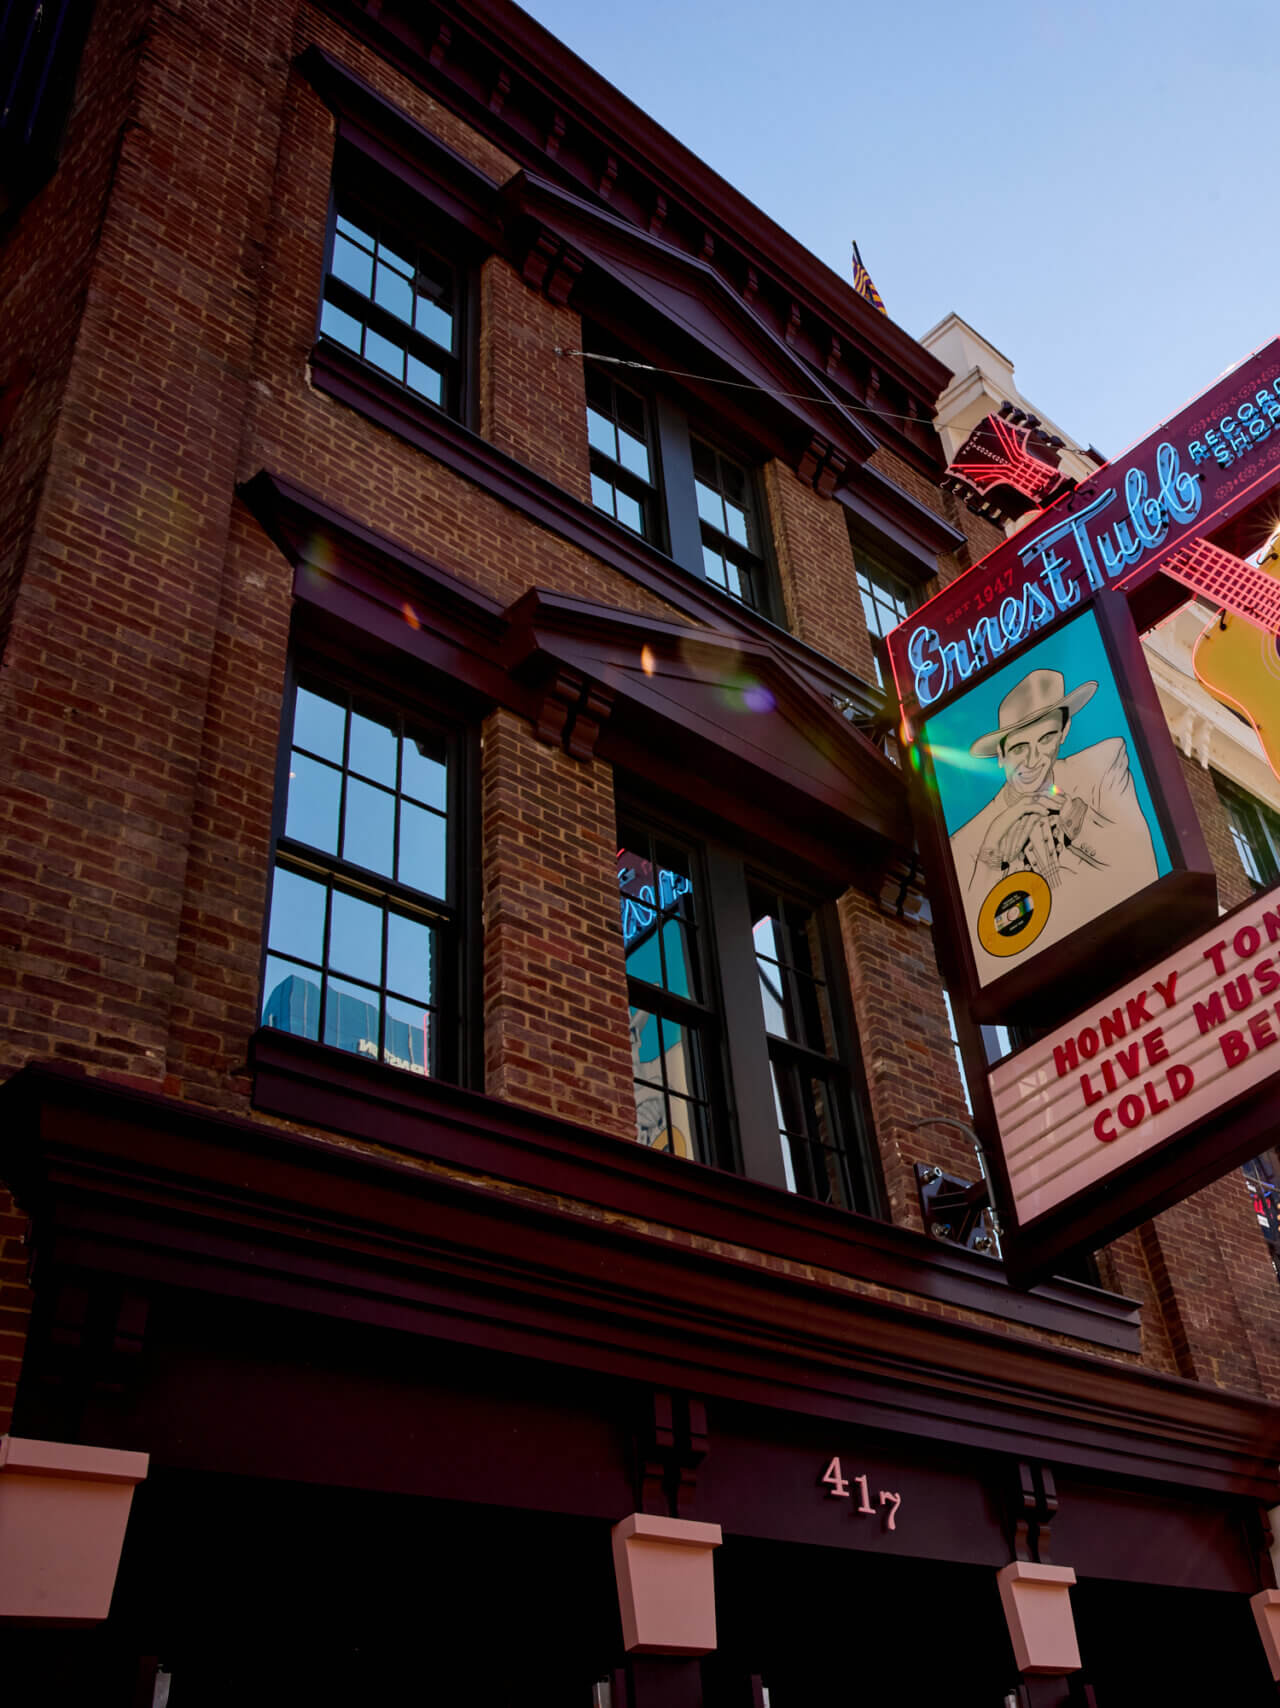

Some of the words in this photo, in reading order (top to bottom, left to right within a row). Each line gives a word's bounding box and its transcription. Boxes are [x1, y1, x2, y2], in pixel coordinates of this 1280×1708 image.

[907, 549, 1082, 708] Ernest
[1017, 441, 1202, 597] Tubb
[974, 567, 1014, 611] 1947
[1053, 971, 1178, 1076] HONKY
[1080, 1027, 1171, 1107] LIVE
[1093, 1064, 1196, 1144] COLD
[822, 1456, 901, 1531] 417
